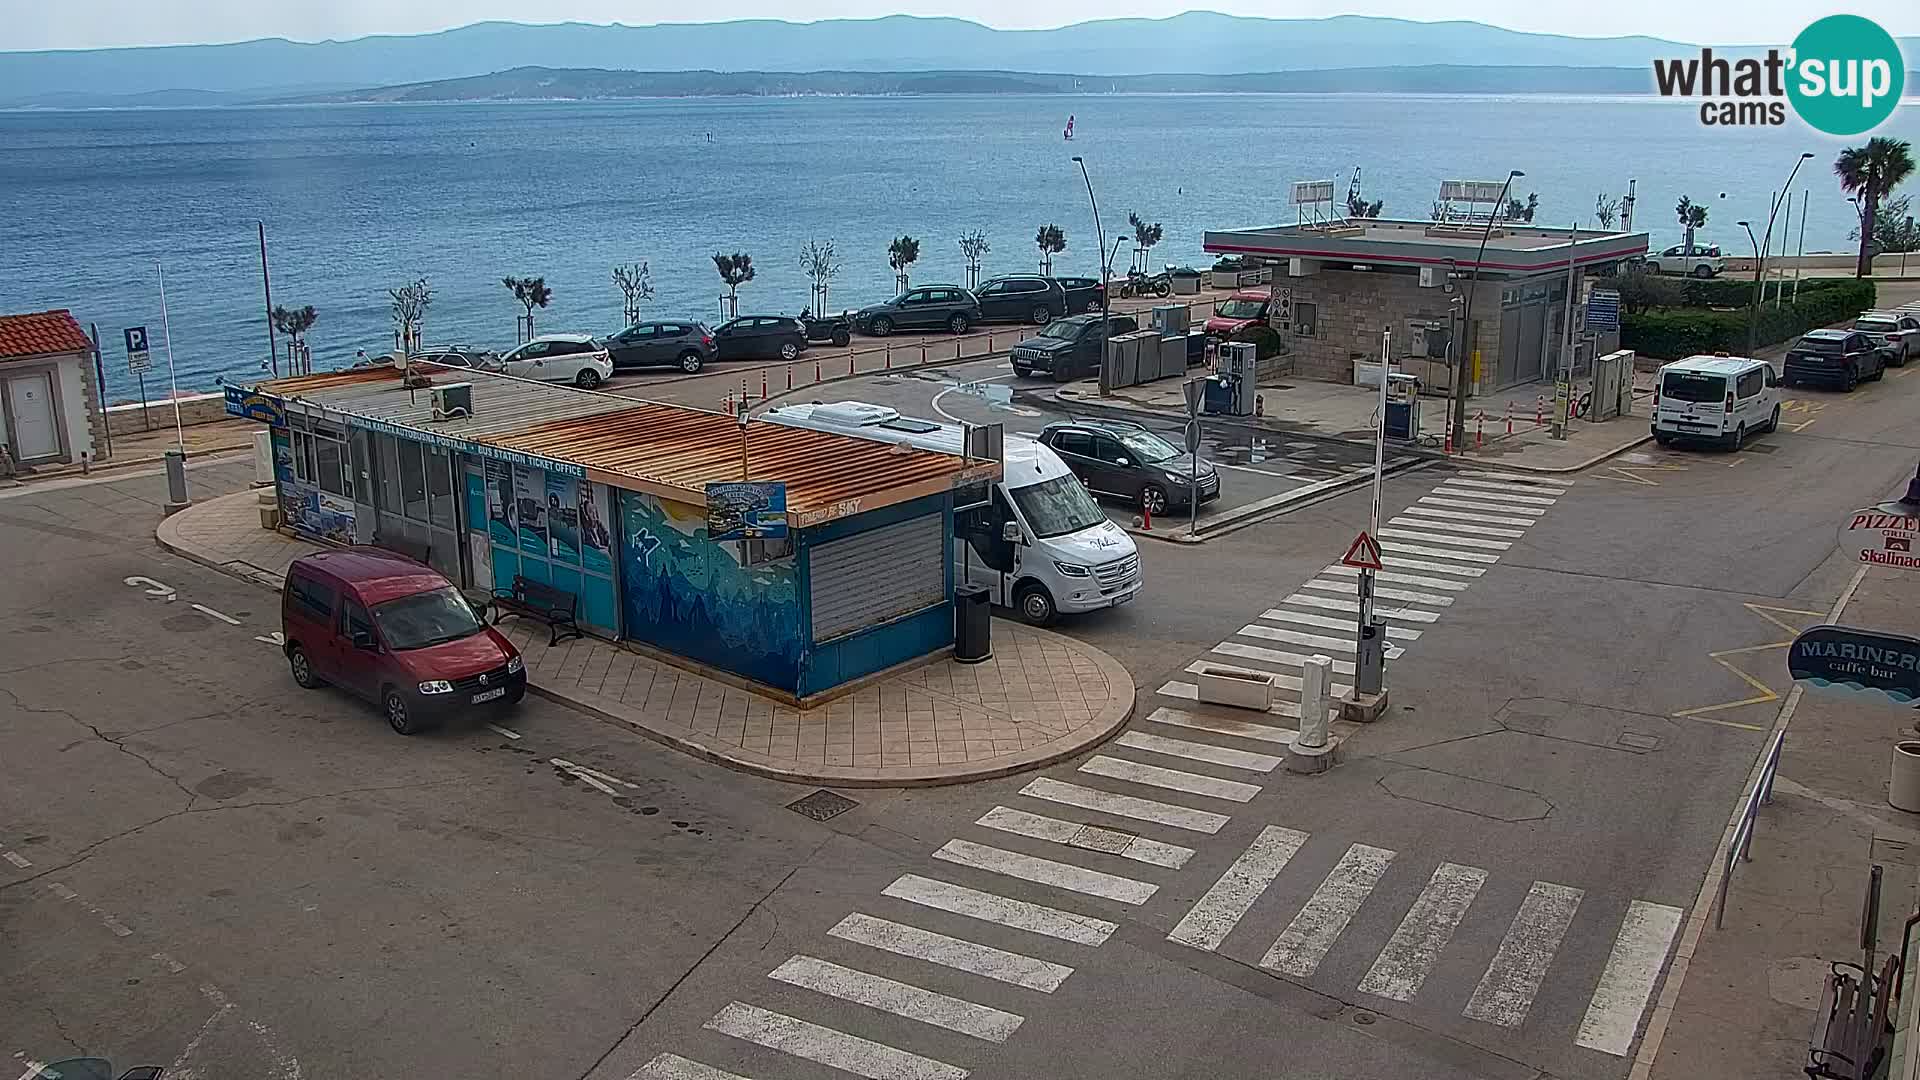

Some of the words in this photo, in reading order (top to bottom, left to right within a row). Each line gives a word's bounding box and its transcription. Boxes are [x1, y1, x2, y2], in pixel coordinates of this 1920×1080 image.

[130, 330, 142, 349] P
[436, 436, 467, 451] POSTAJA
[478, 447, 493, 457] BUS
[494, 451, 526, 465] STATION
[528, 457, 554, 470] TICKET
[555, 464, 582, 477] OFFICE
[1848, 514, 1920, 533] PIZZE
[1800, 642, 1920, 671] MARINER
[1829, 661, 1866, 674] caffe
[1870, 665, 1897, 680] bar
